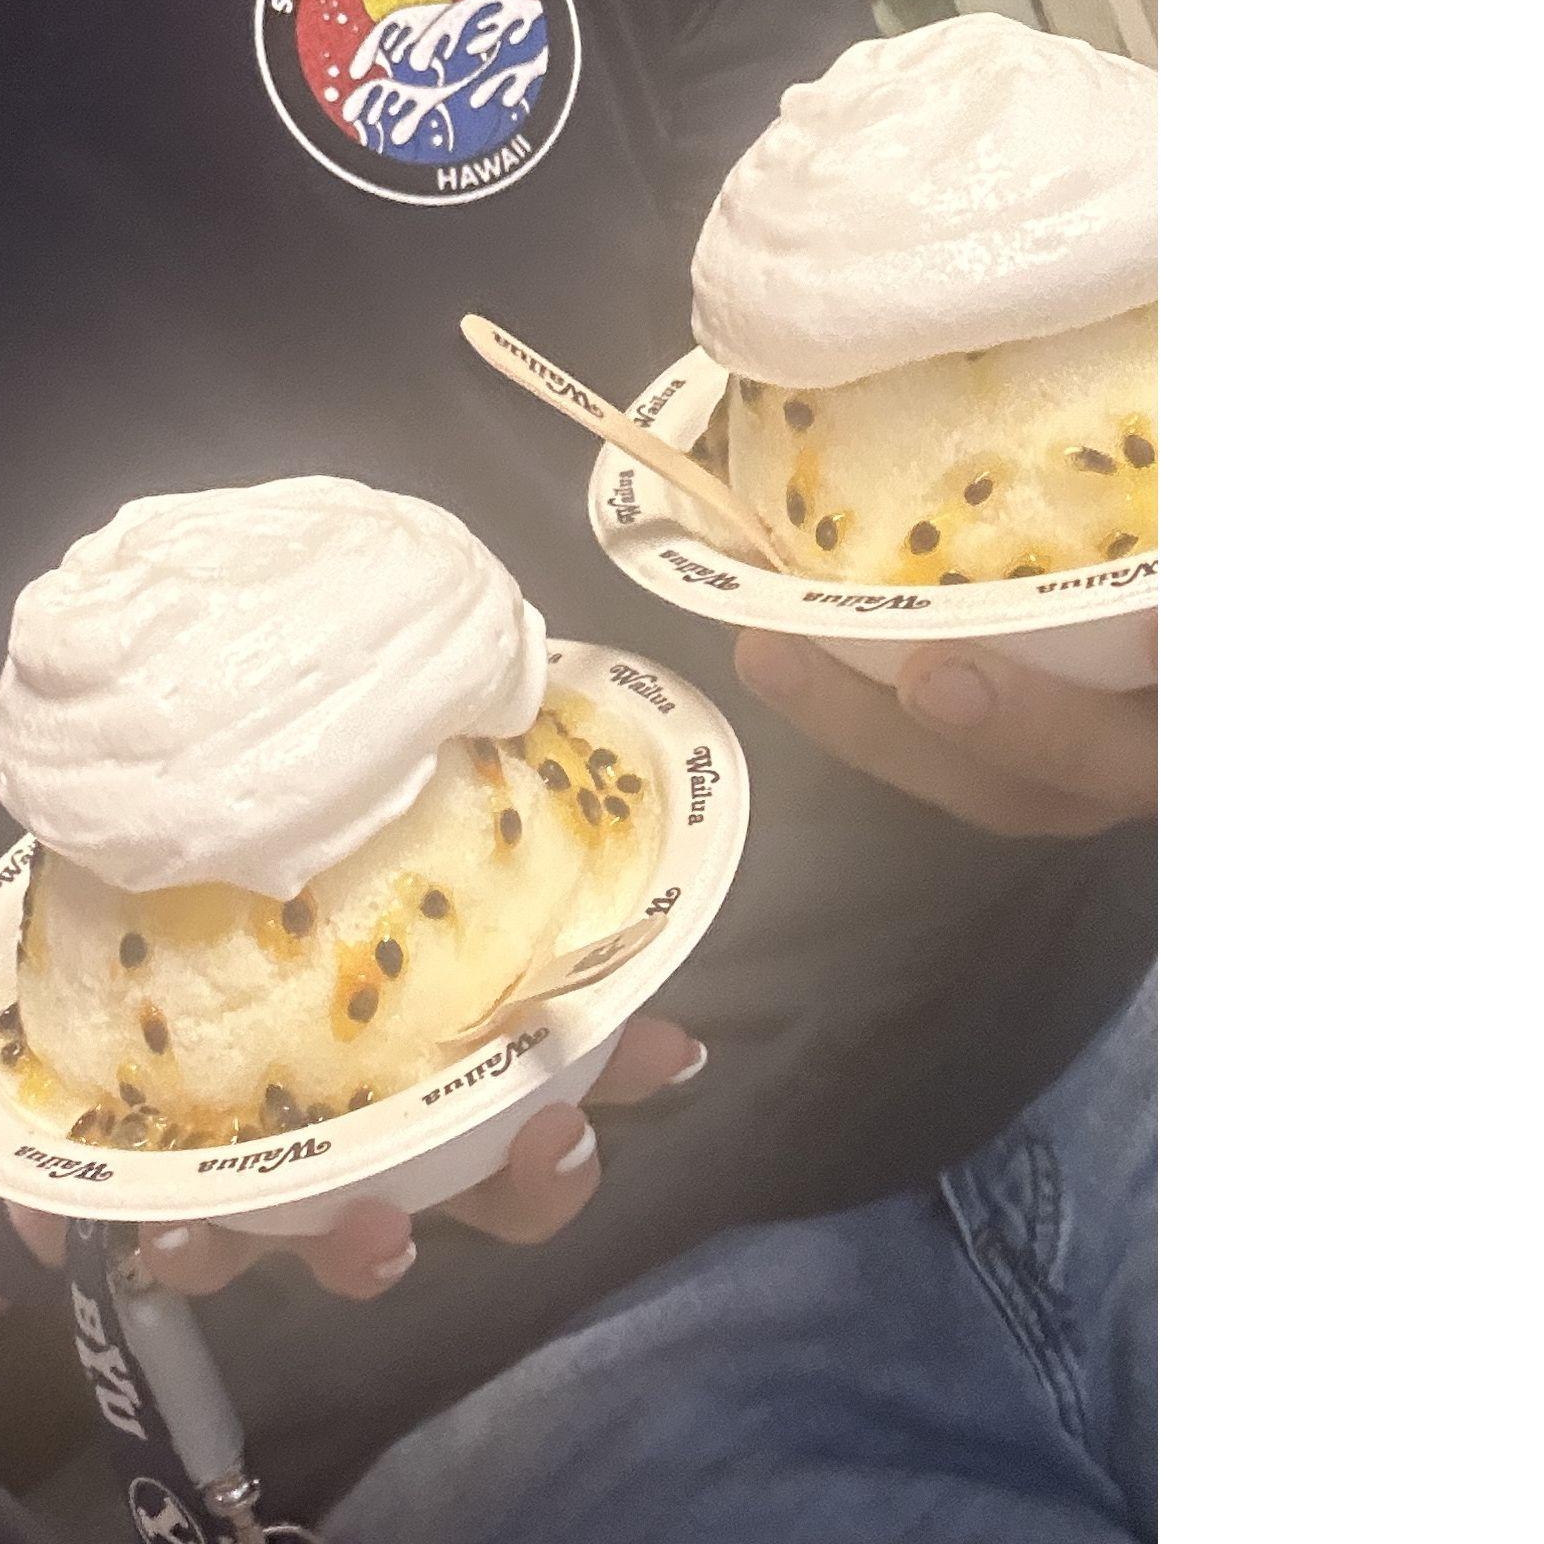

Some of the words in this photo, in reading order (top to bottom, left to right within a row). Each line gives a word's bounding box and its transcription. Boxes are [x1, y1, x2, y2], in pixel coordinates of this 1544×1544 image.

[436, 133, 534, 192] HAWAII
[492, 330, 604, 419] Wailua
[658, 549, 740, 591] Wailua
[802, 591, 932, 612] Wailua
[609, 662, 676, 715] Wailua
[685, 745, 720, 827] Wailua
[421, 1024, 551, 1107] Wailua
[13, 1144, 115, 1183] Wailua
[197, 1137, 332, 1174] Wailua
[71, 1280, 149, 1441] BYU
